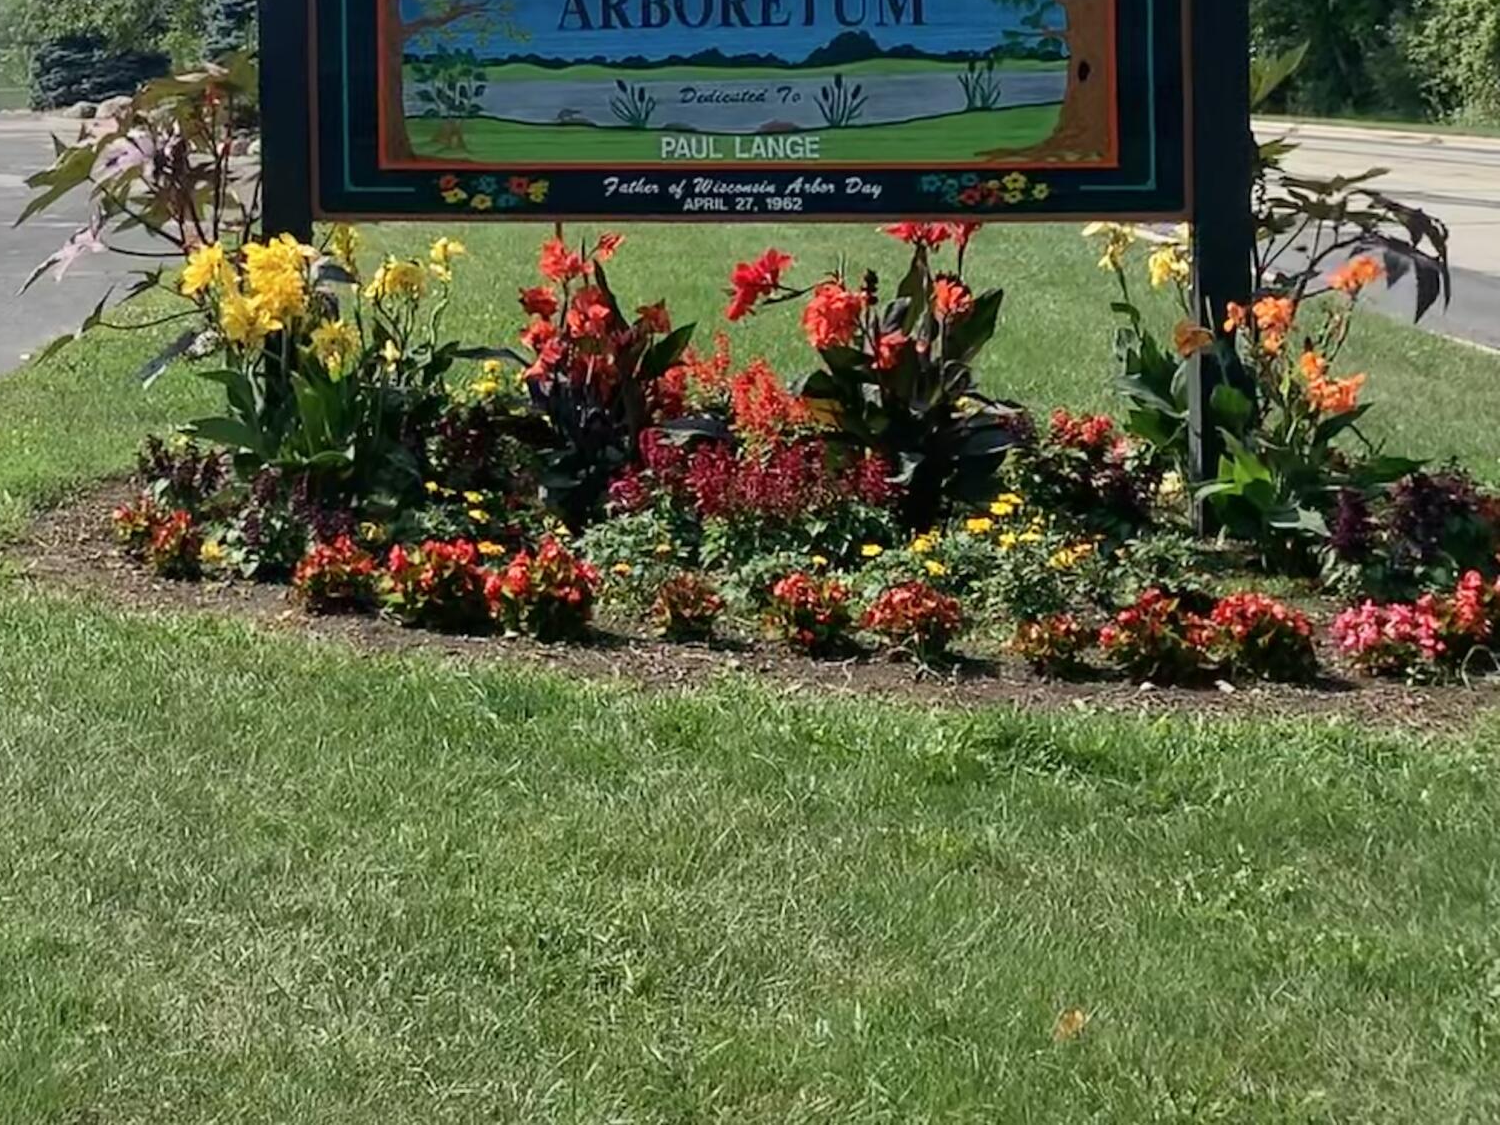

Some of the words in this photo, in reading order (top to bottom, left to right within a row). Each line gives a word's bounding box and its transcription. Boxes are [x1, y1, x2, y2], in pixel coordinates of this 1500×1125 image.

[678, 86, 769, 104] Dedicated
[776, 86, 802, 104] To
[661, 136, 724, 159] PAUL
[734, 136, 820, 159] LANGE
[602, 176, 660, 197] Father
[668, 178, 685, 199] of
[693, 176, 776, 195] Wisconsin
[784, 176, 836, 195] Arbor
[845, 177, 883, 199] Day
[683, 196, 728, 212] APRIL
[734, 196, 759, 213] 27,
[765, 196, 803, 212] 1962
